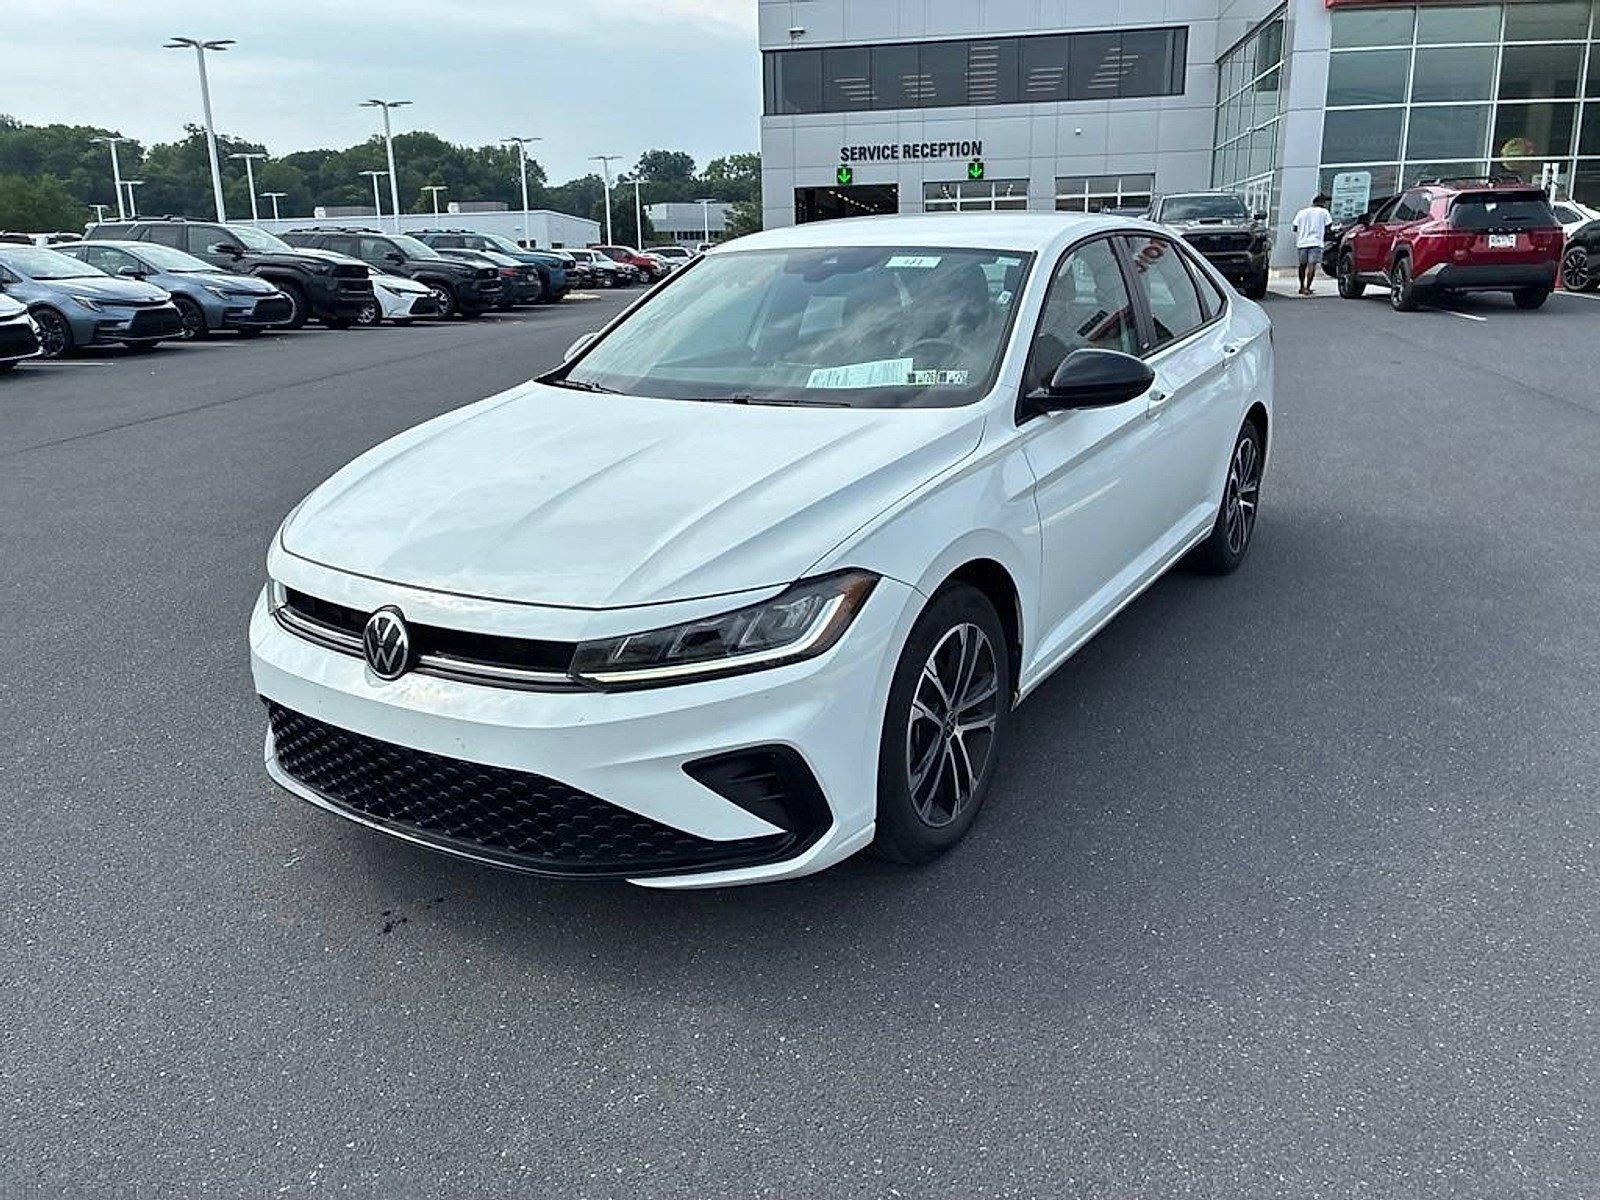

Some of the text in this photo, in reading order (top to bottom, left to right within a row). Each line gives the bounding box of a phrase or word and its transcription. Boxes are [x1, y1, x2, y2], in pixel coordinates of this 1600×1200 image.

[840, 140, 983, 161] SERVICE RECEPTION
[364, 611, 408, 678] VW
